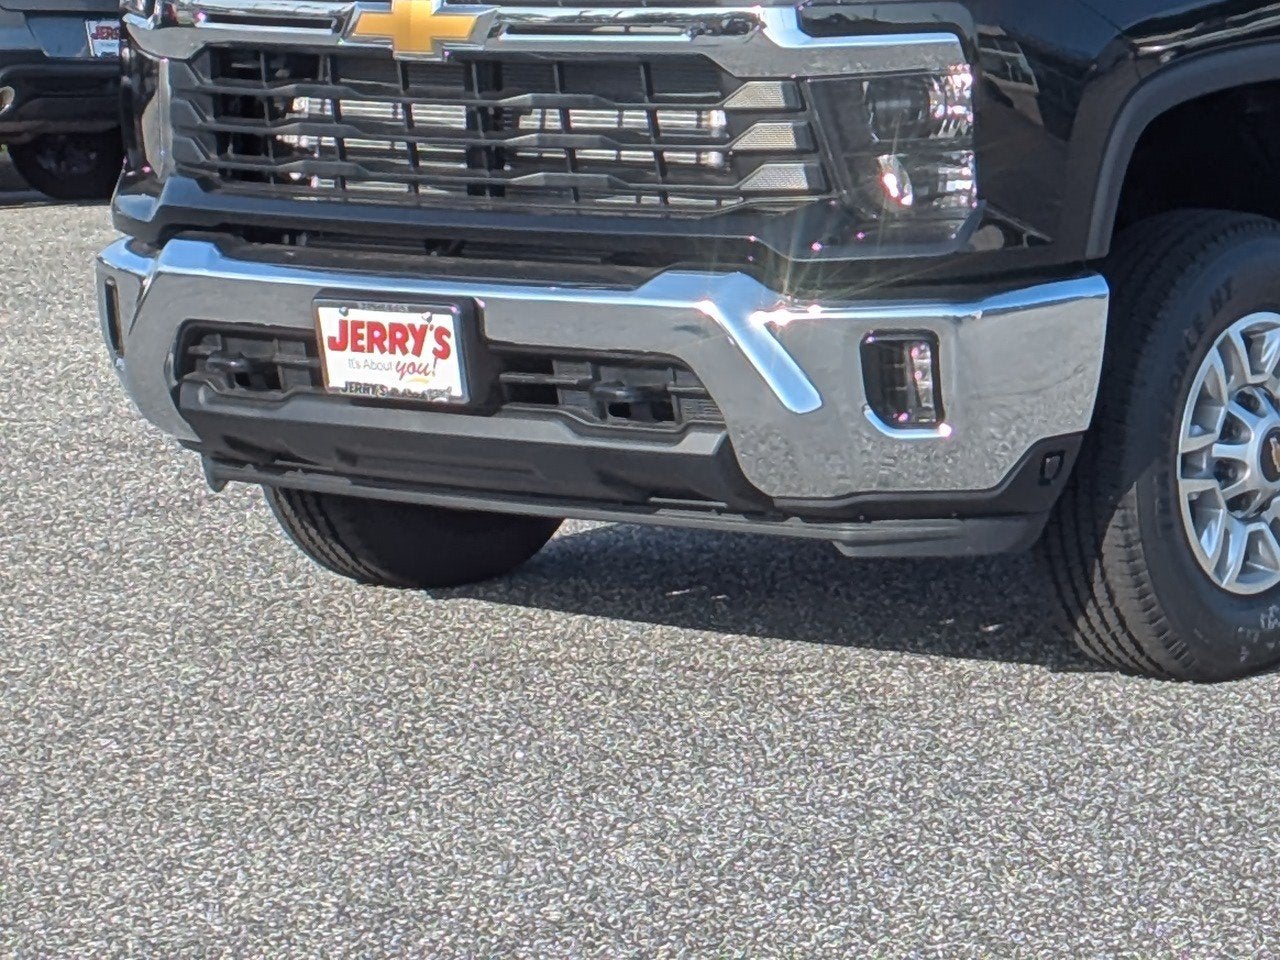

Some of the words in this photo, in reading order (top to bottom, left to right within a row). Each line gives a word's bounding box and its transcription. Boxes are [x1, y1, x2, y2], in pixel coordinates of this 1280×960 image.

[328, 319, 452, 360] JERRY'S
[363, 359, 394, 372] About
[395, 358, 438, 380] you!
